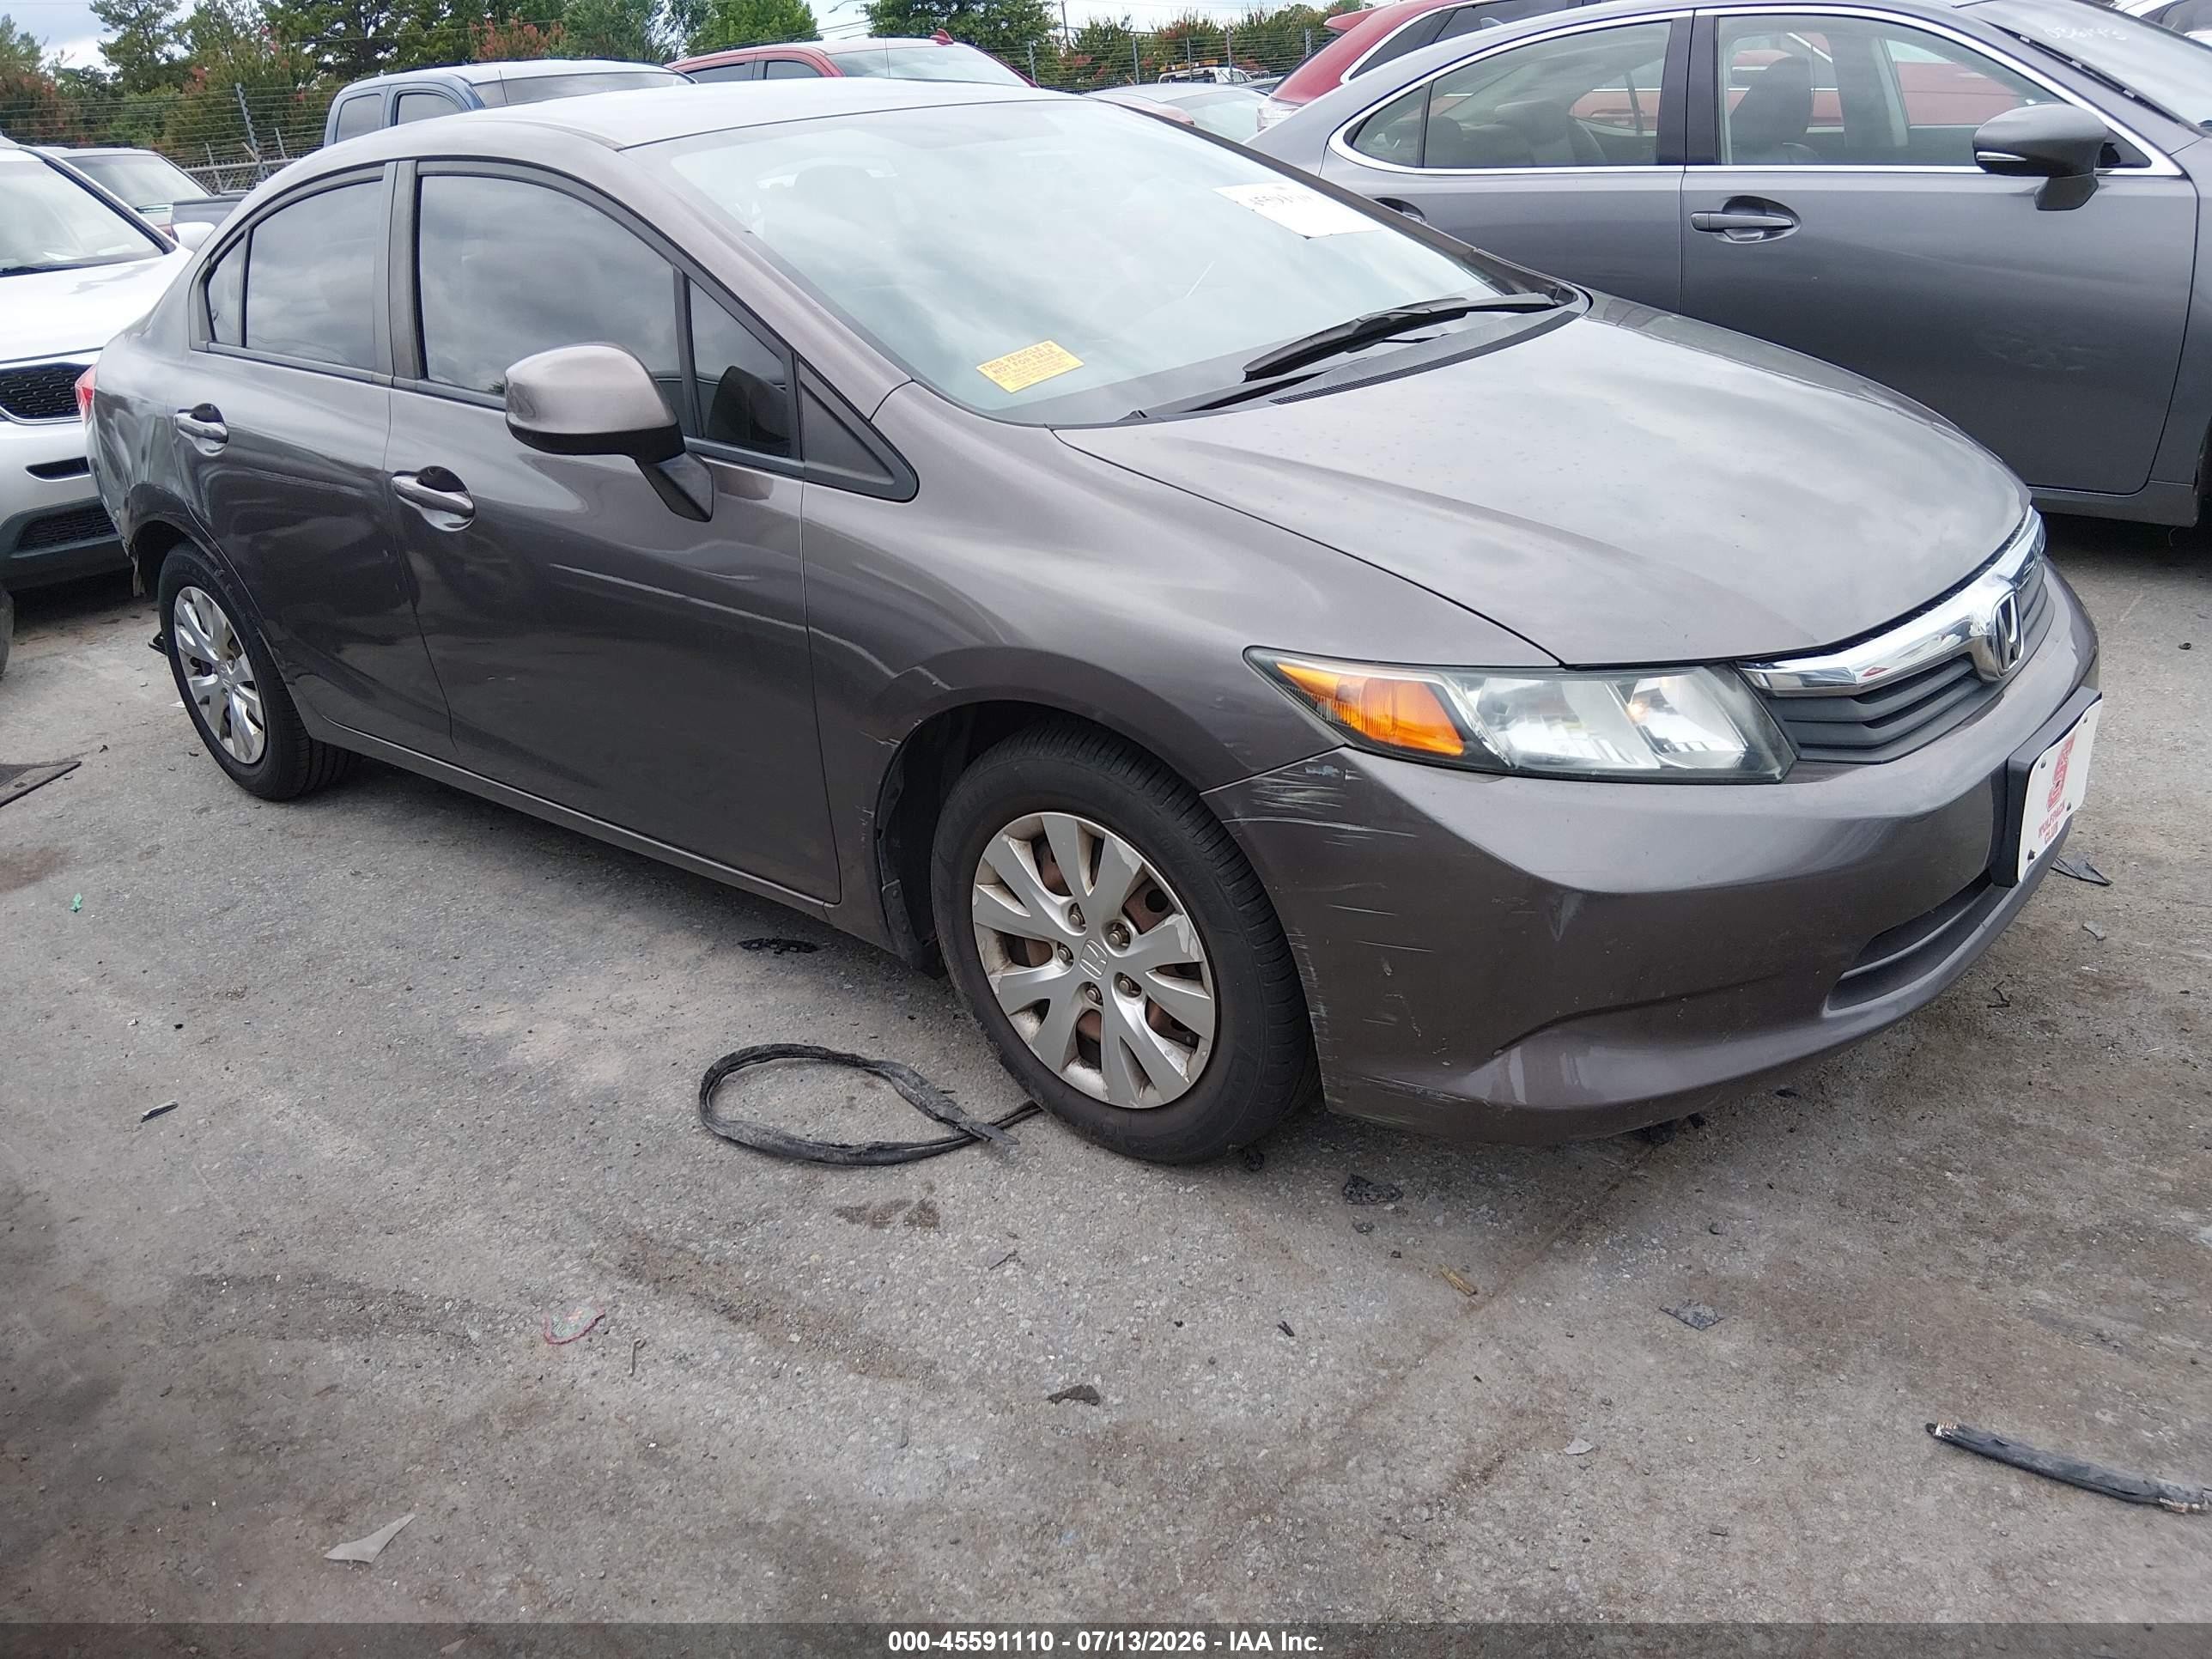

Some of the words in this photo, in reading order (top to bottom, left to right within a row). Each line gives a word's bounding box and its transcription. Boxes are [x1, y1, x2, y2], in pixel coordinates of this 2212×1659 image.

[981, 361, 1004, 371] THIS
[1006, 345, 1044, 363] VEHICLE
[993, 364, 1012, 374] NOT
[1013, 356, 1033, 367] FOR
[1033, 348, 1056, 360] SALE
